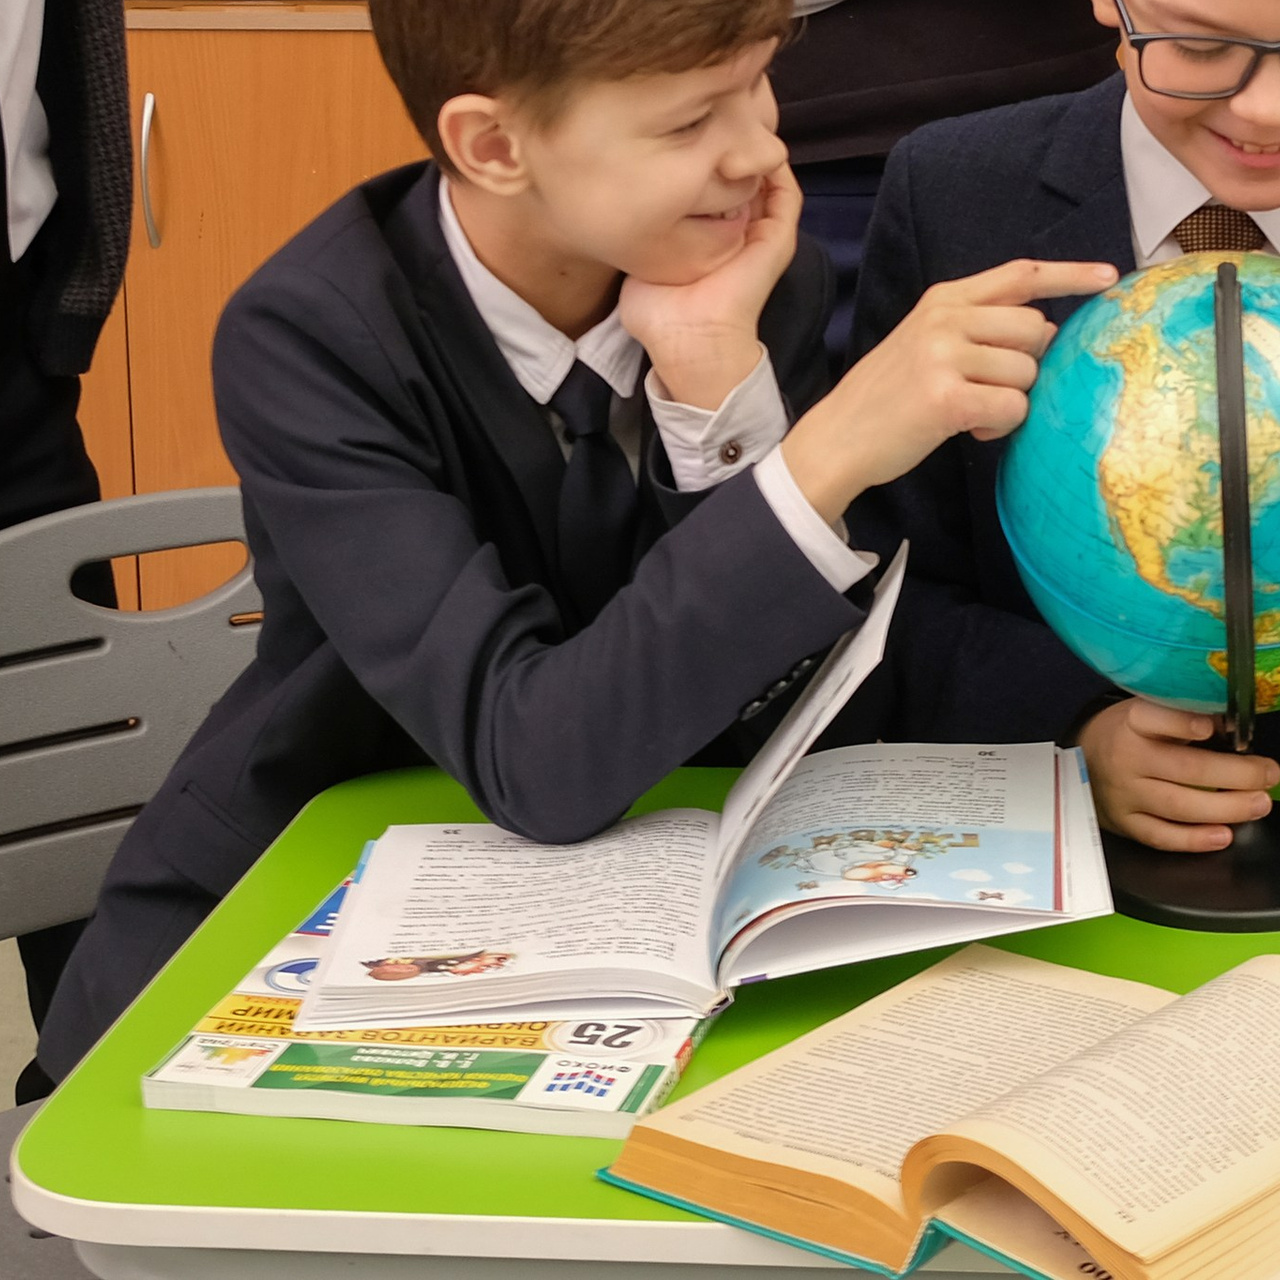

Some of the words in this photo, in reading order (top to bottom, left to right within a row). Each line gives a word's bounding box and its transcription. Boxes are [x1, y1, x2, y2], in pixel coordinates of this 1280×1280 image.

[232, 1006, 298, 1020] МИР
[362, 1030, 539, 1047] ВАРИАНТОВ
[567, 1022, 641, 1048] 25
[555, 1060, 631, 1073] ФИОКО
